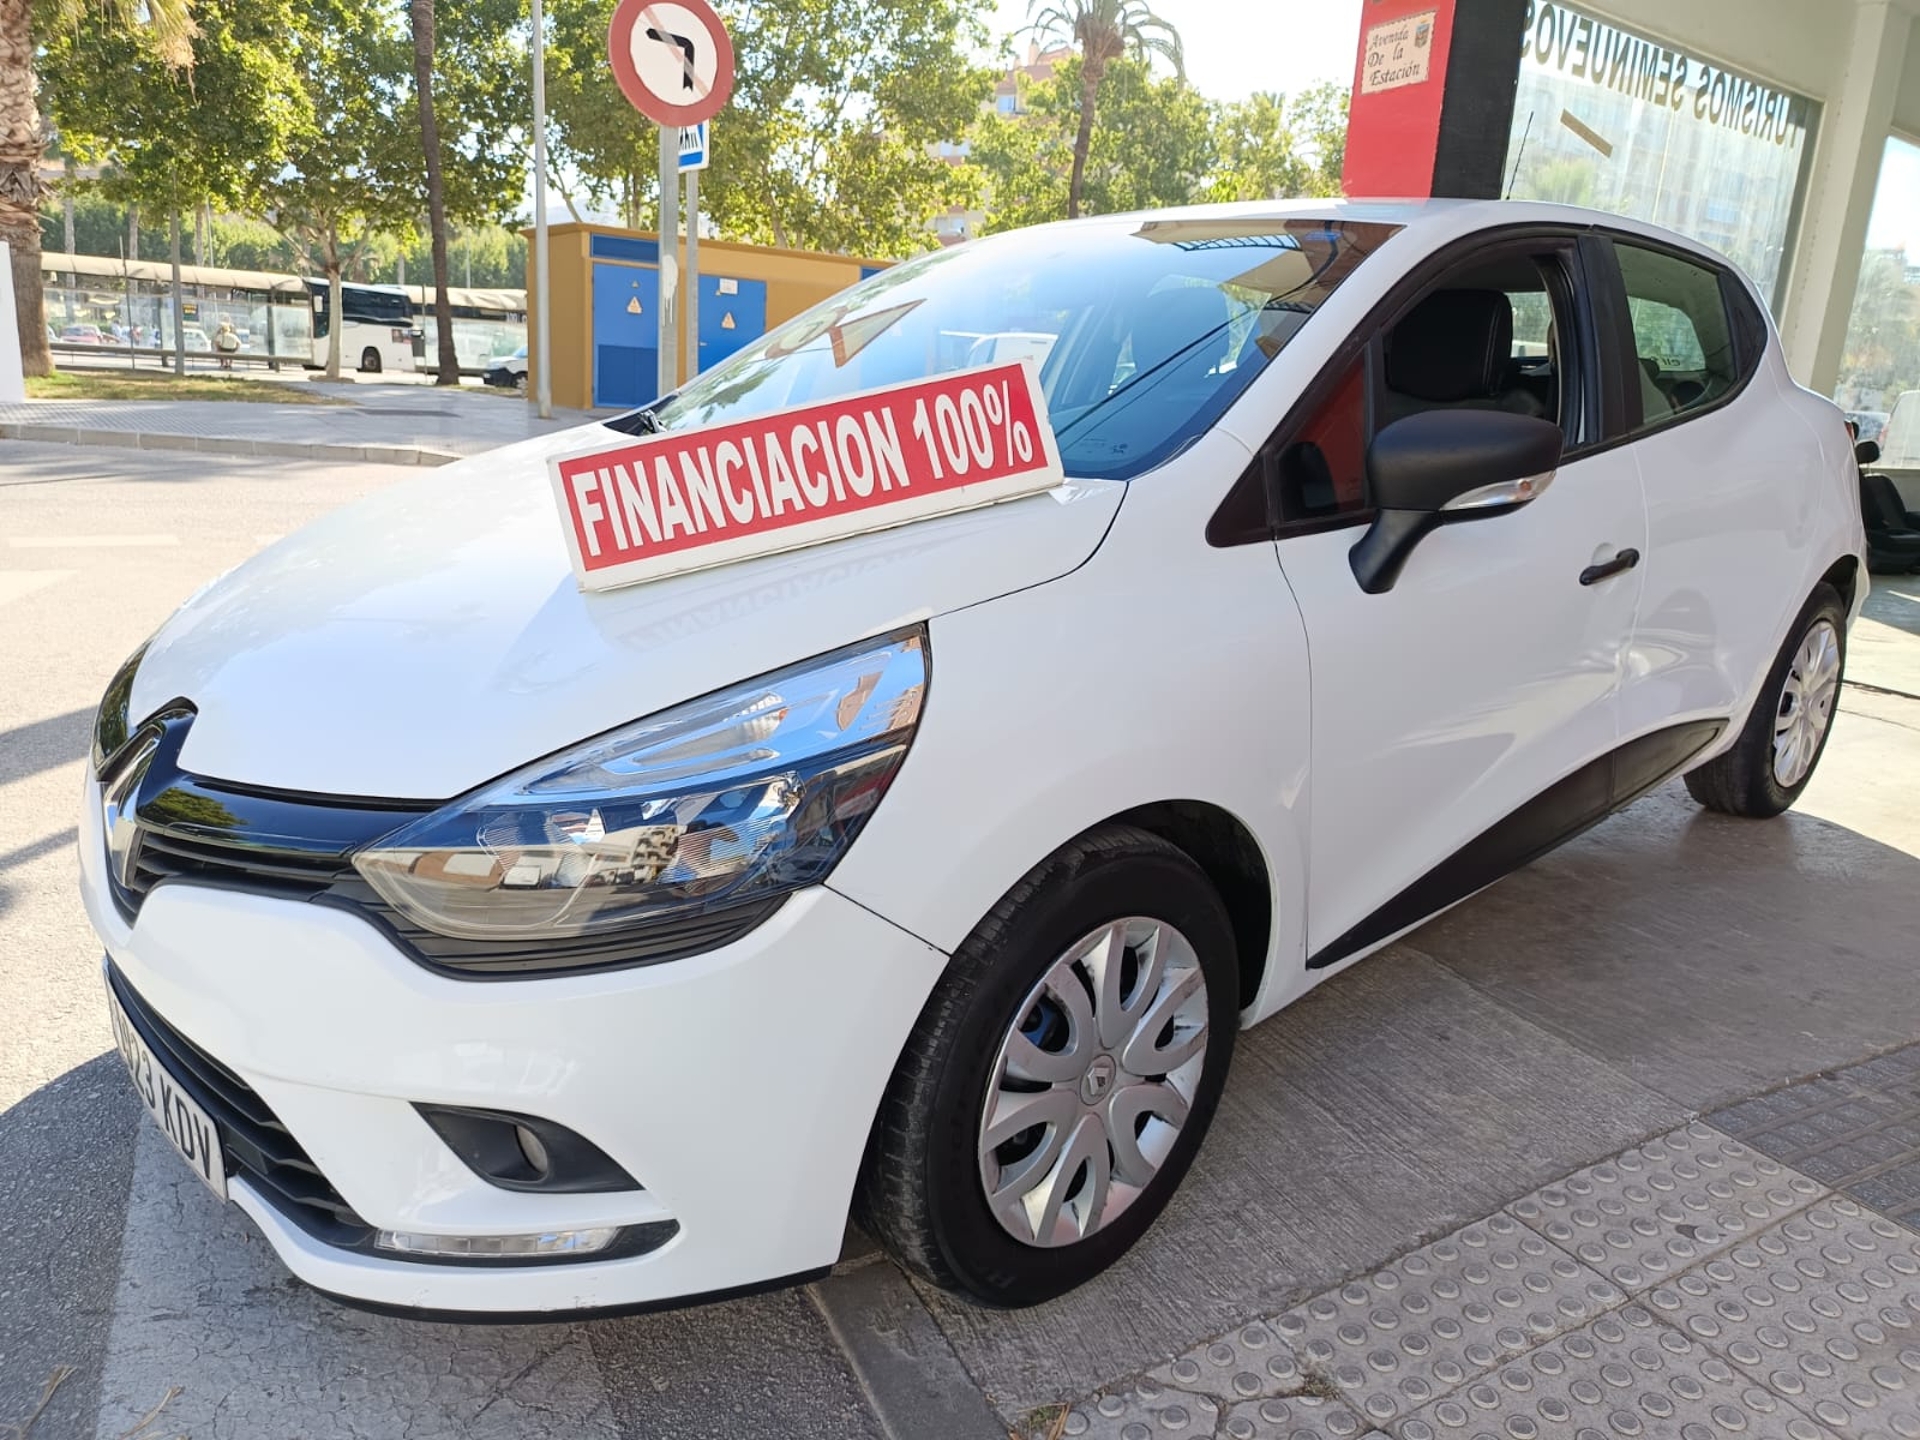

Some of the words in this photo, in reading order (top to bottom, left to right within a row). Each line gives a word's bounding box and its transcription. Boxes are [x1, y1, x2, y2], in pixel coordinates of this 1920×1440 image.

[1369, 24, 1409, 51] Avenida
[1368, 52, 1385, 67] De
[1393, 42, 1404, 61] la
[1370, 60, 1421, 86] Estación
[571, 407, 909, 557] FINANCIACION
[913, 379, 1034, 480] 100%
[159, 1072, 212, 1181] KDV
